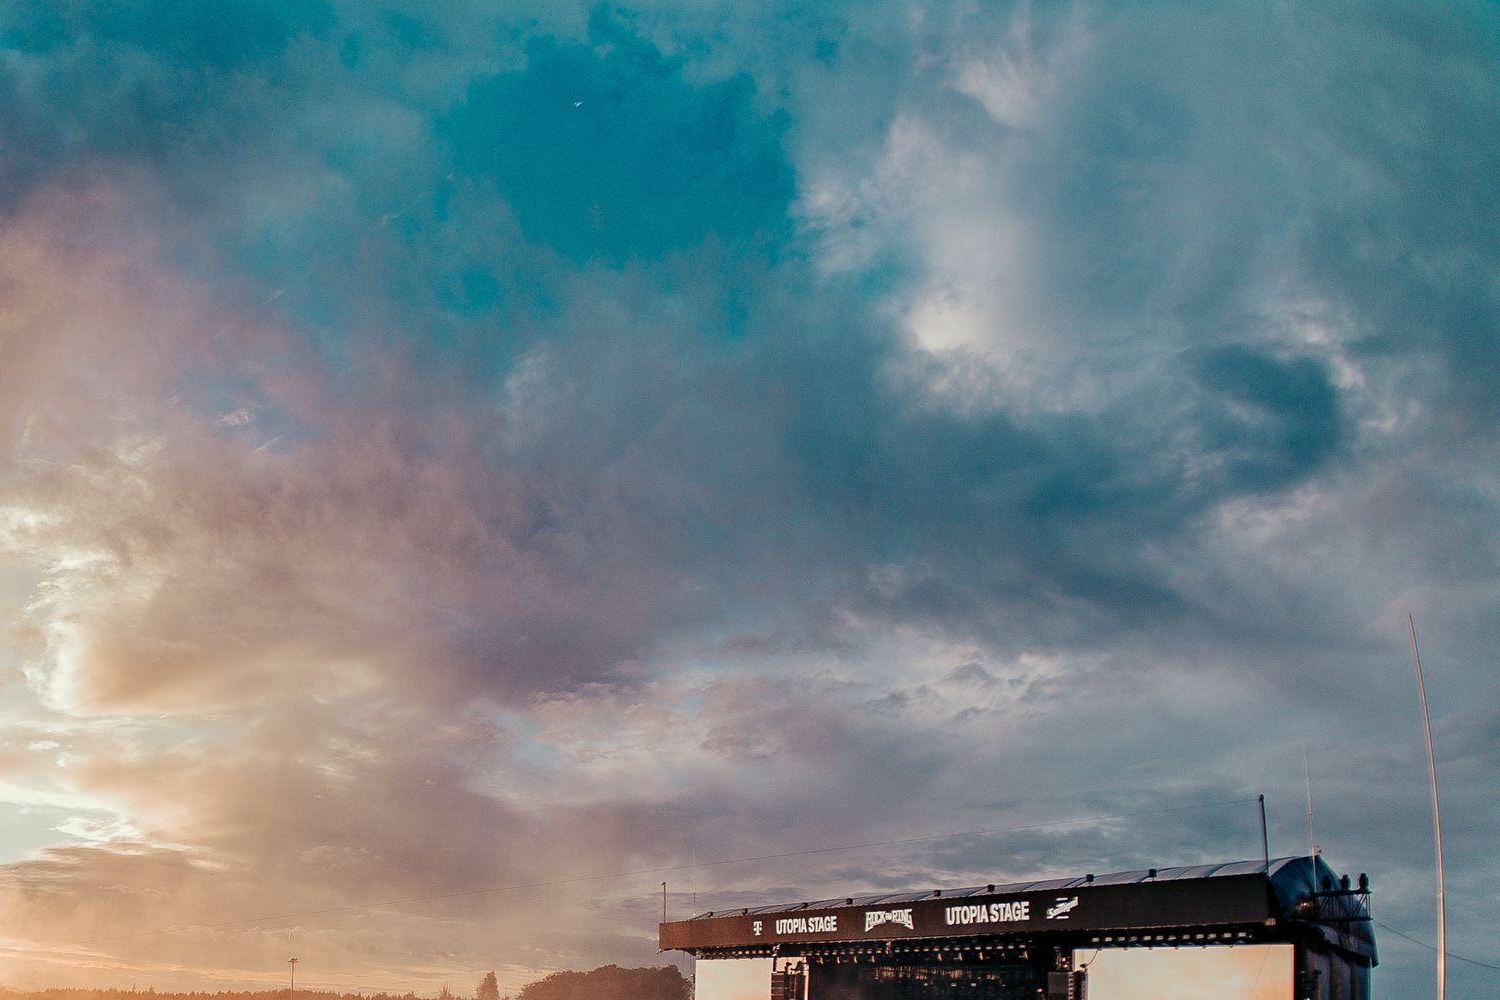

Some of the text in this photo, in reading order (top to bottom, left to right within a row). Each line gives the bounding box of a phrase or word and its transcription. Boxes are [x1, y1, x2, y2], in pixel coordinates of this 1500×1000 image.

[892, 909, 915, 930] RING
[946, 904, 990, 926] UTOPIA
[990, 901, 1031, 923] STAGE
[776, 916, 838, 934] UTOPIA STAGE
